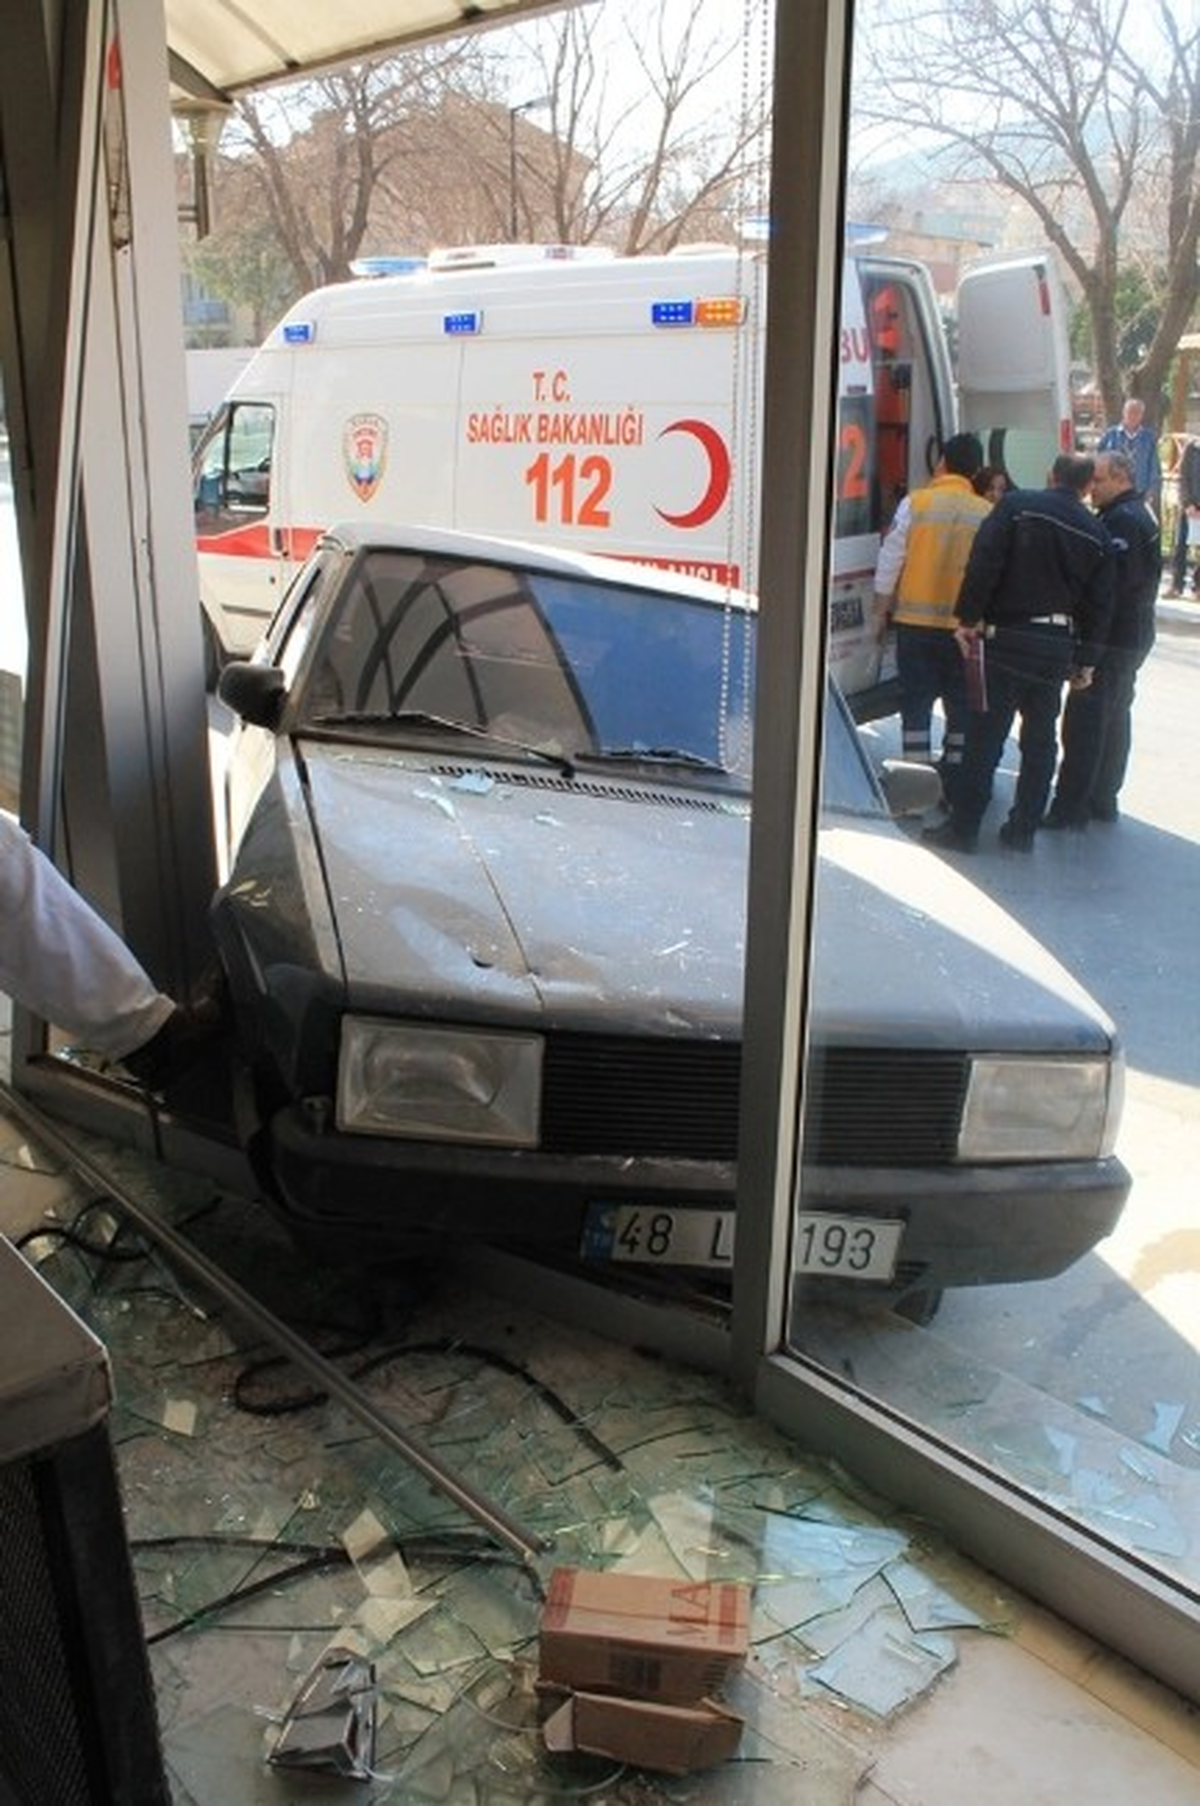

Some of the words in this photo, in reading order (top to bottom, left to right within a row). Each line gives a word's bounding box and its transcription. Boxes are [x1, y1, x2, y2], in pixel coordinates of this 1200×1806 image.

[841, 328, 870, 363] BU
[467, 406, 532, 444] SAĞLIK
[537, 407, 643, 446] BAKANLIĞI
[526, 452, 612, 528] 112
[840, 423, 868, 498] 2
[618, 1212, 673, 1256] 48
[709, 1215, 732, 1262] L
[801, 1222, 876, 1271] 193
